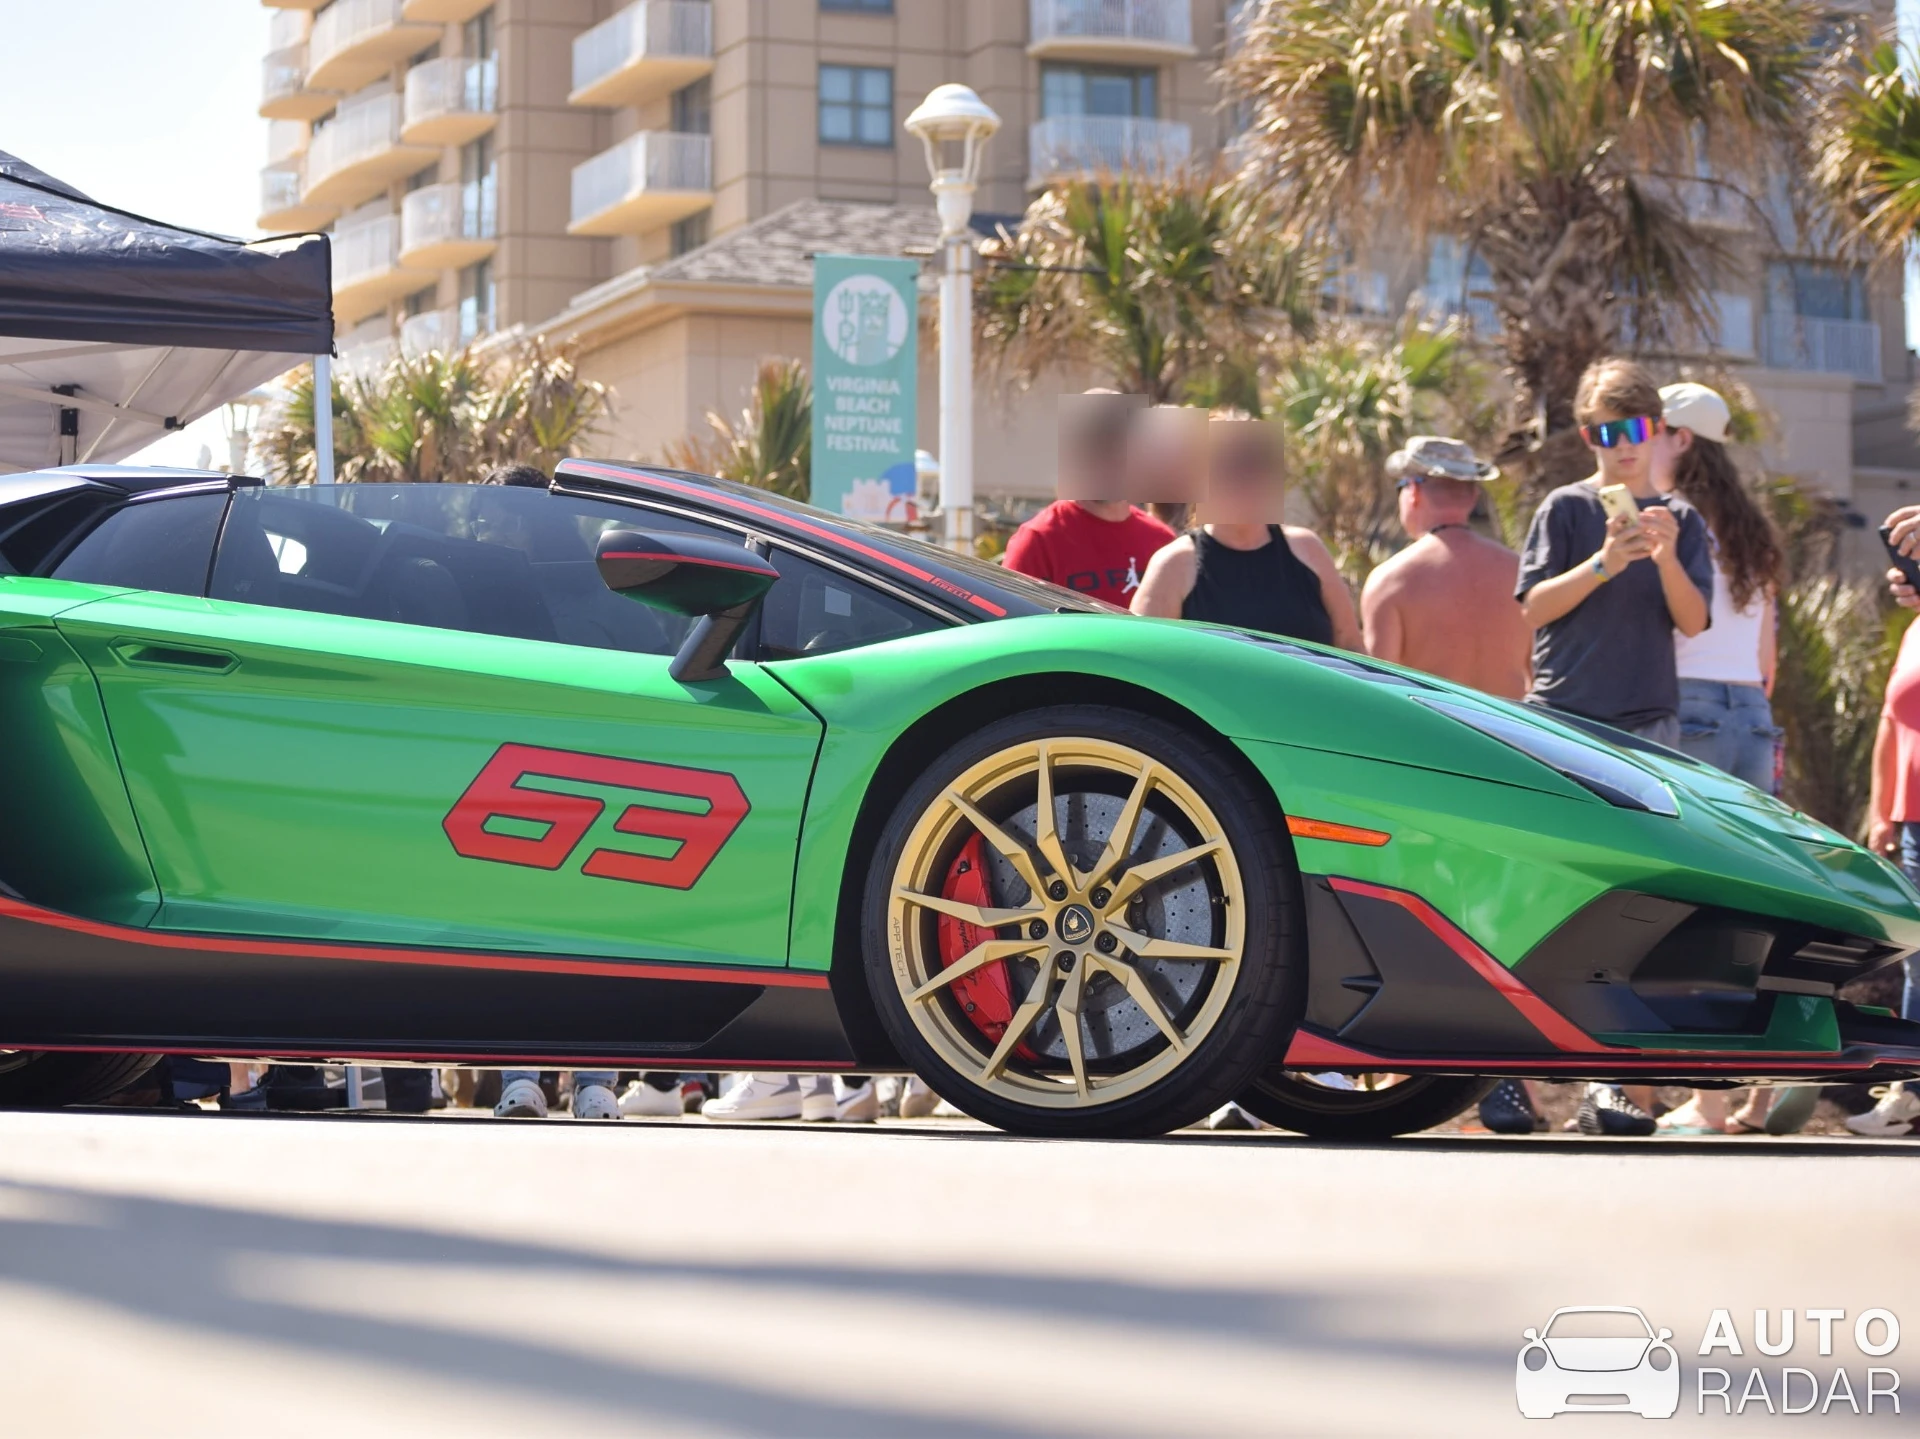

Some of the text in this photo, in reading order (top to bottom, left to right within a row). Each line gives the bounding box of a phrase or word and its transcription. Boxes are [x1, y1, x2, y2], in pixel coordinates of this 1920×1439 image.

[825, 376, 901, 395] VIRGINIA
[835, 396, 890, 414] BEACH
[824, 415, 902, 434] NEPTUNE
[826, 434, 900, 453] FESTIVAL
[442, 741, 752, 891] 63
[893, 917, 907, 977] APP TECH
